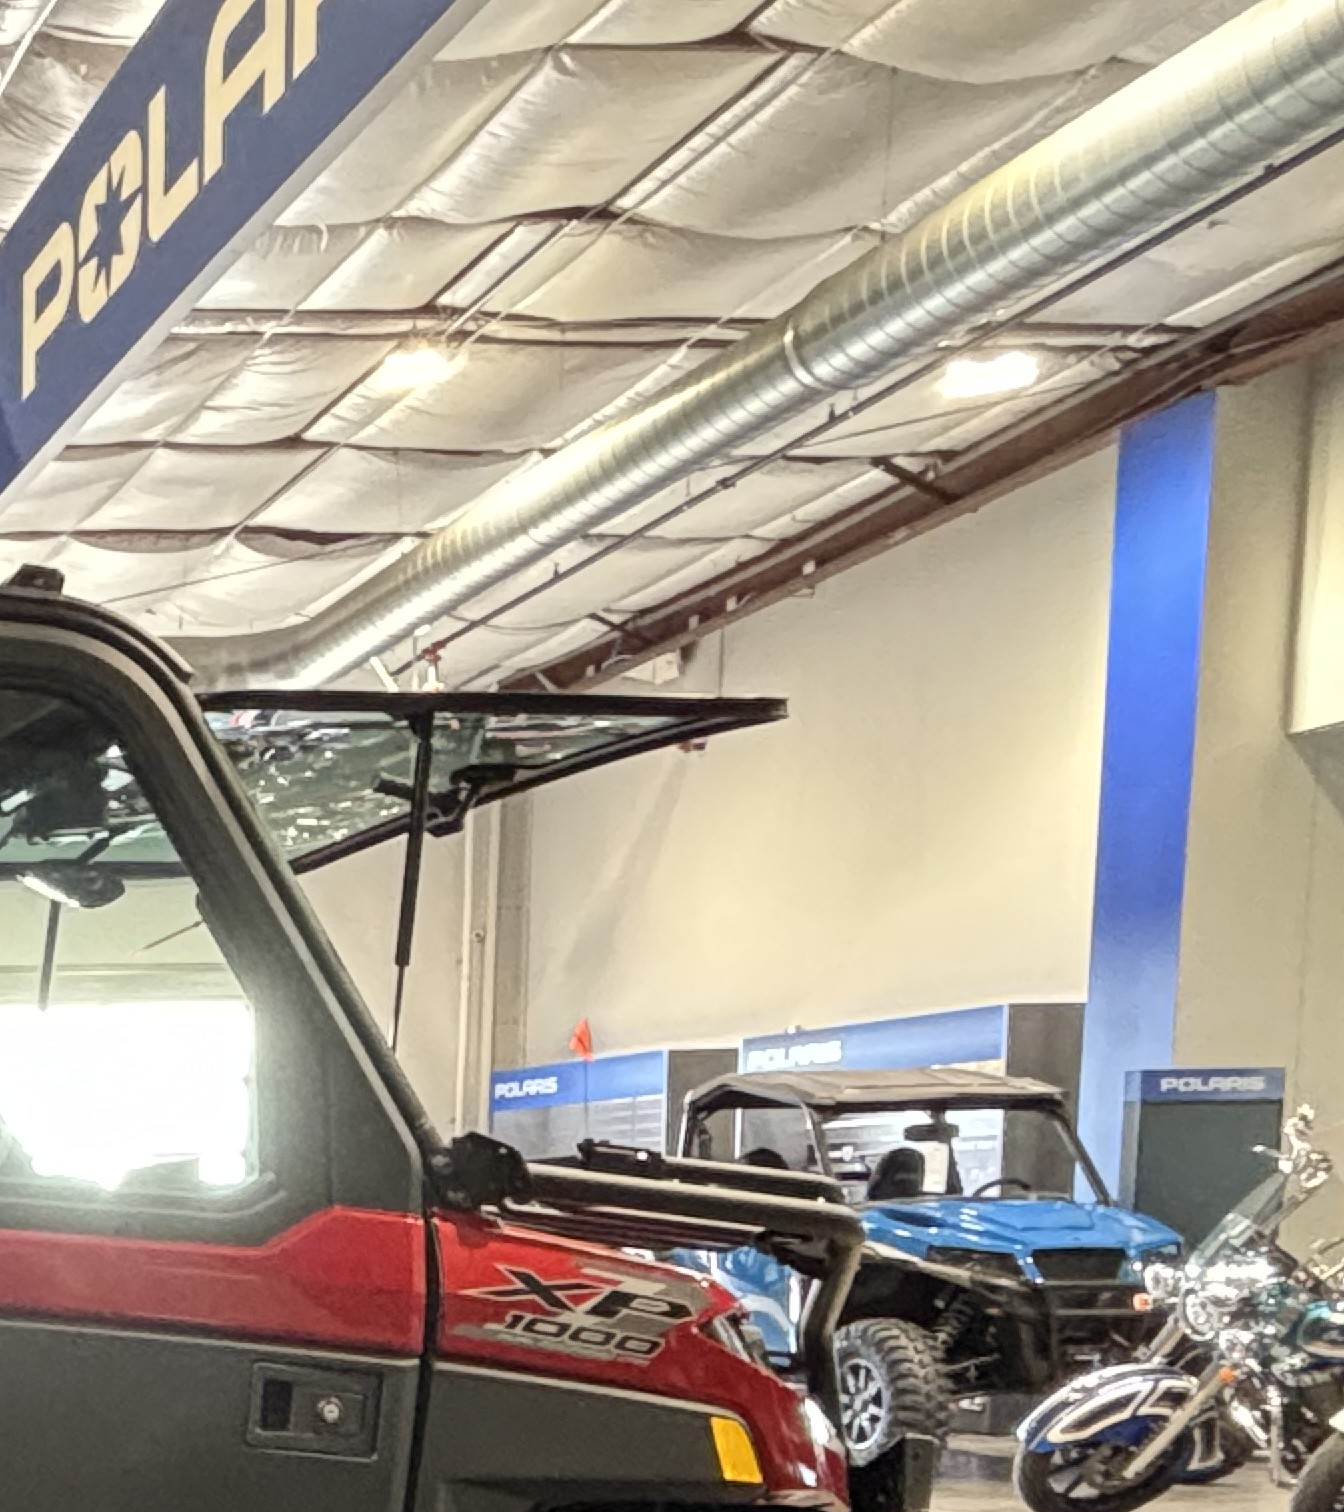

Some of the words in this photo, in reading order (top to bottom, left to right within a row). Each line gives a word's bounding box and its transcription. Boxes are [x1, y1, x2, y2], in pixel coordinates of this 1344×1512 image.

[21, 0, 318, 401] POLA
[746, 1040, 842, 1072] POLARIS
[494, 1076, 558, 1100] POLARIS
[1160, 1076, 1266, 1092] POLARIS
[458, 1264, 699, 1324] XP
[502, 1311, 664, 1358] 1000
